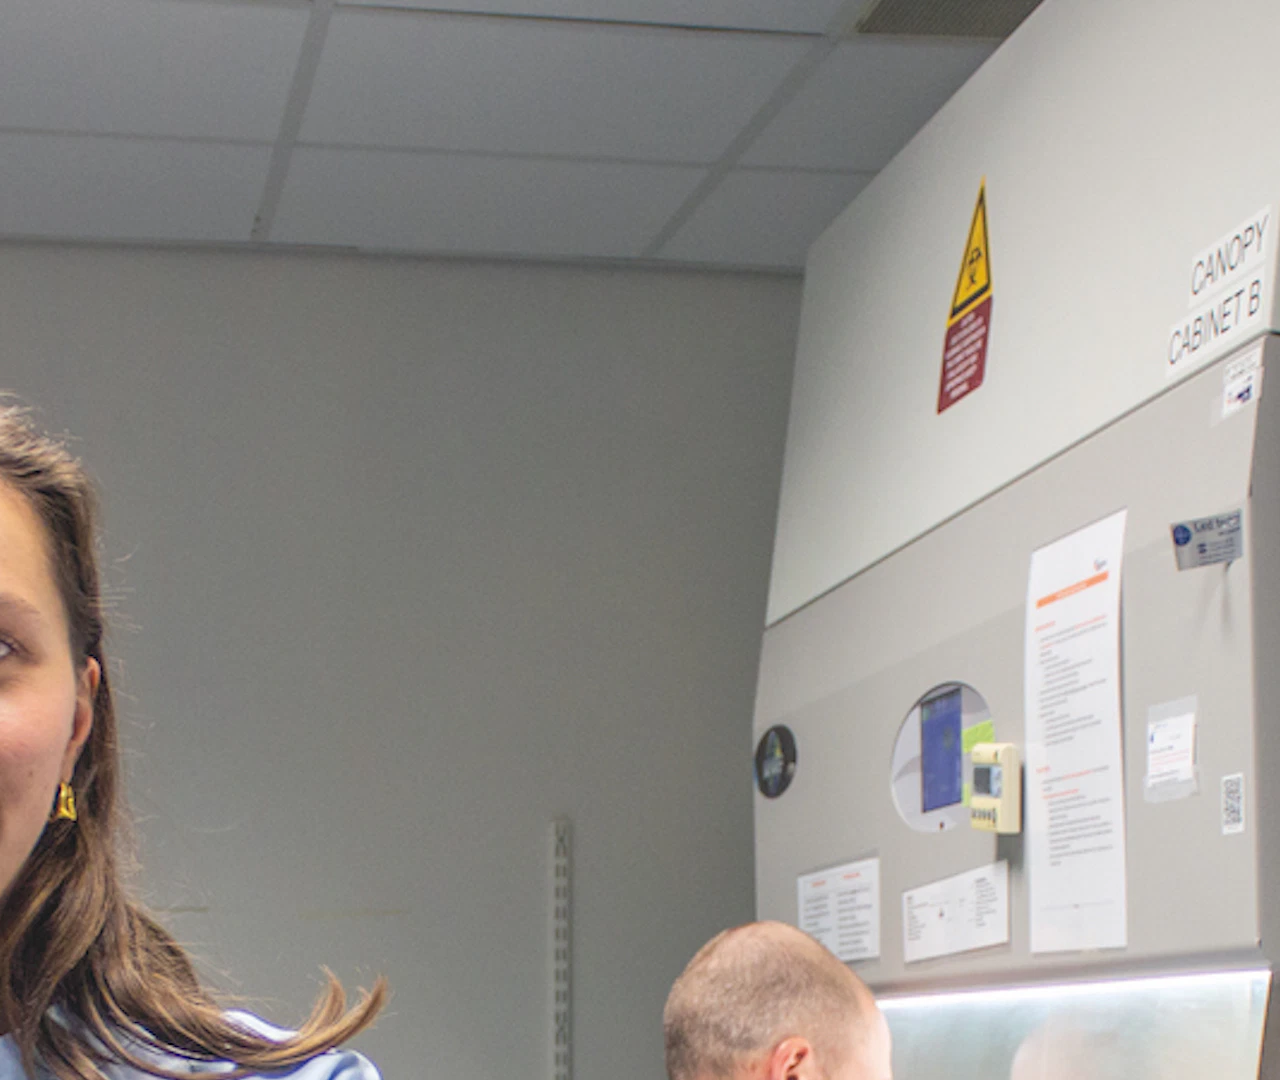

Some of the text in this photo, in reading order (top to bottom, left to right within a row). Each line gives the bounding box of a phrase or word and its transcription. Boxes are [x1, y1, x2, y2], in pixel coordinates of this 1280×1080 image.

[1192, 213, 1269, 295] CANOPY
[1168, 279, 1261, 364] CABINET B
